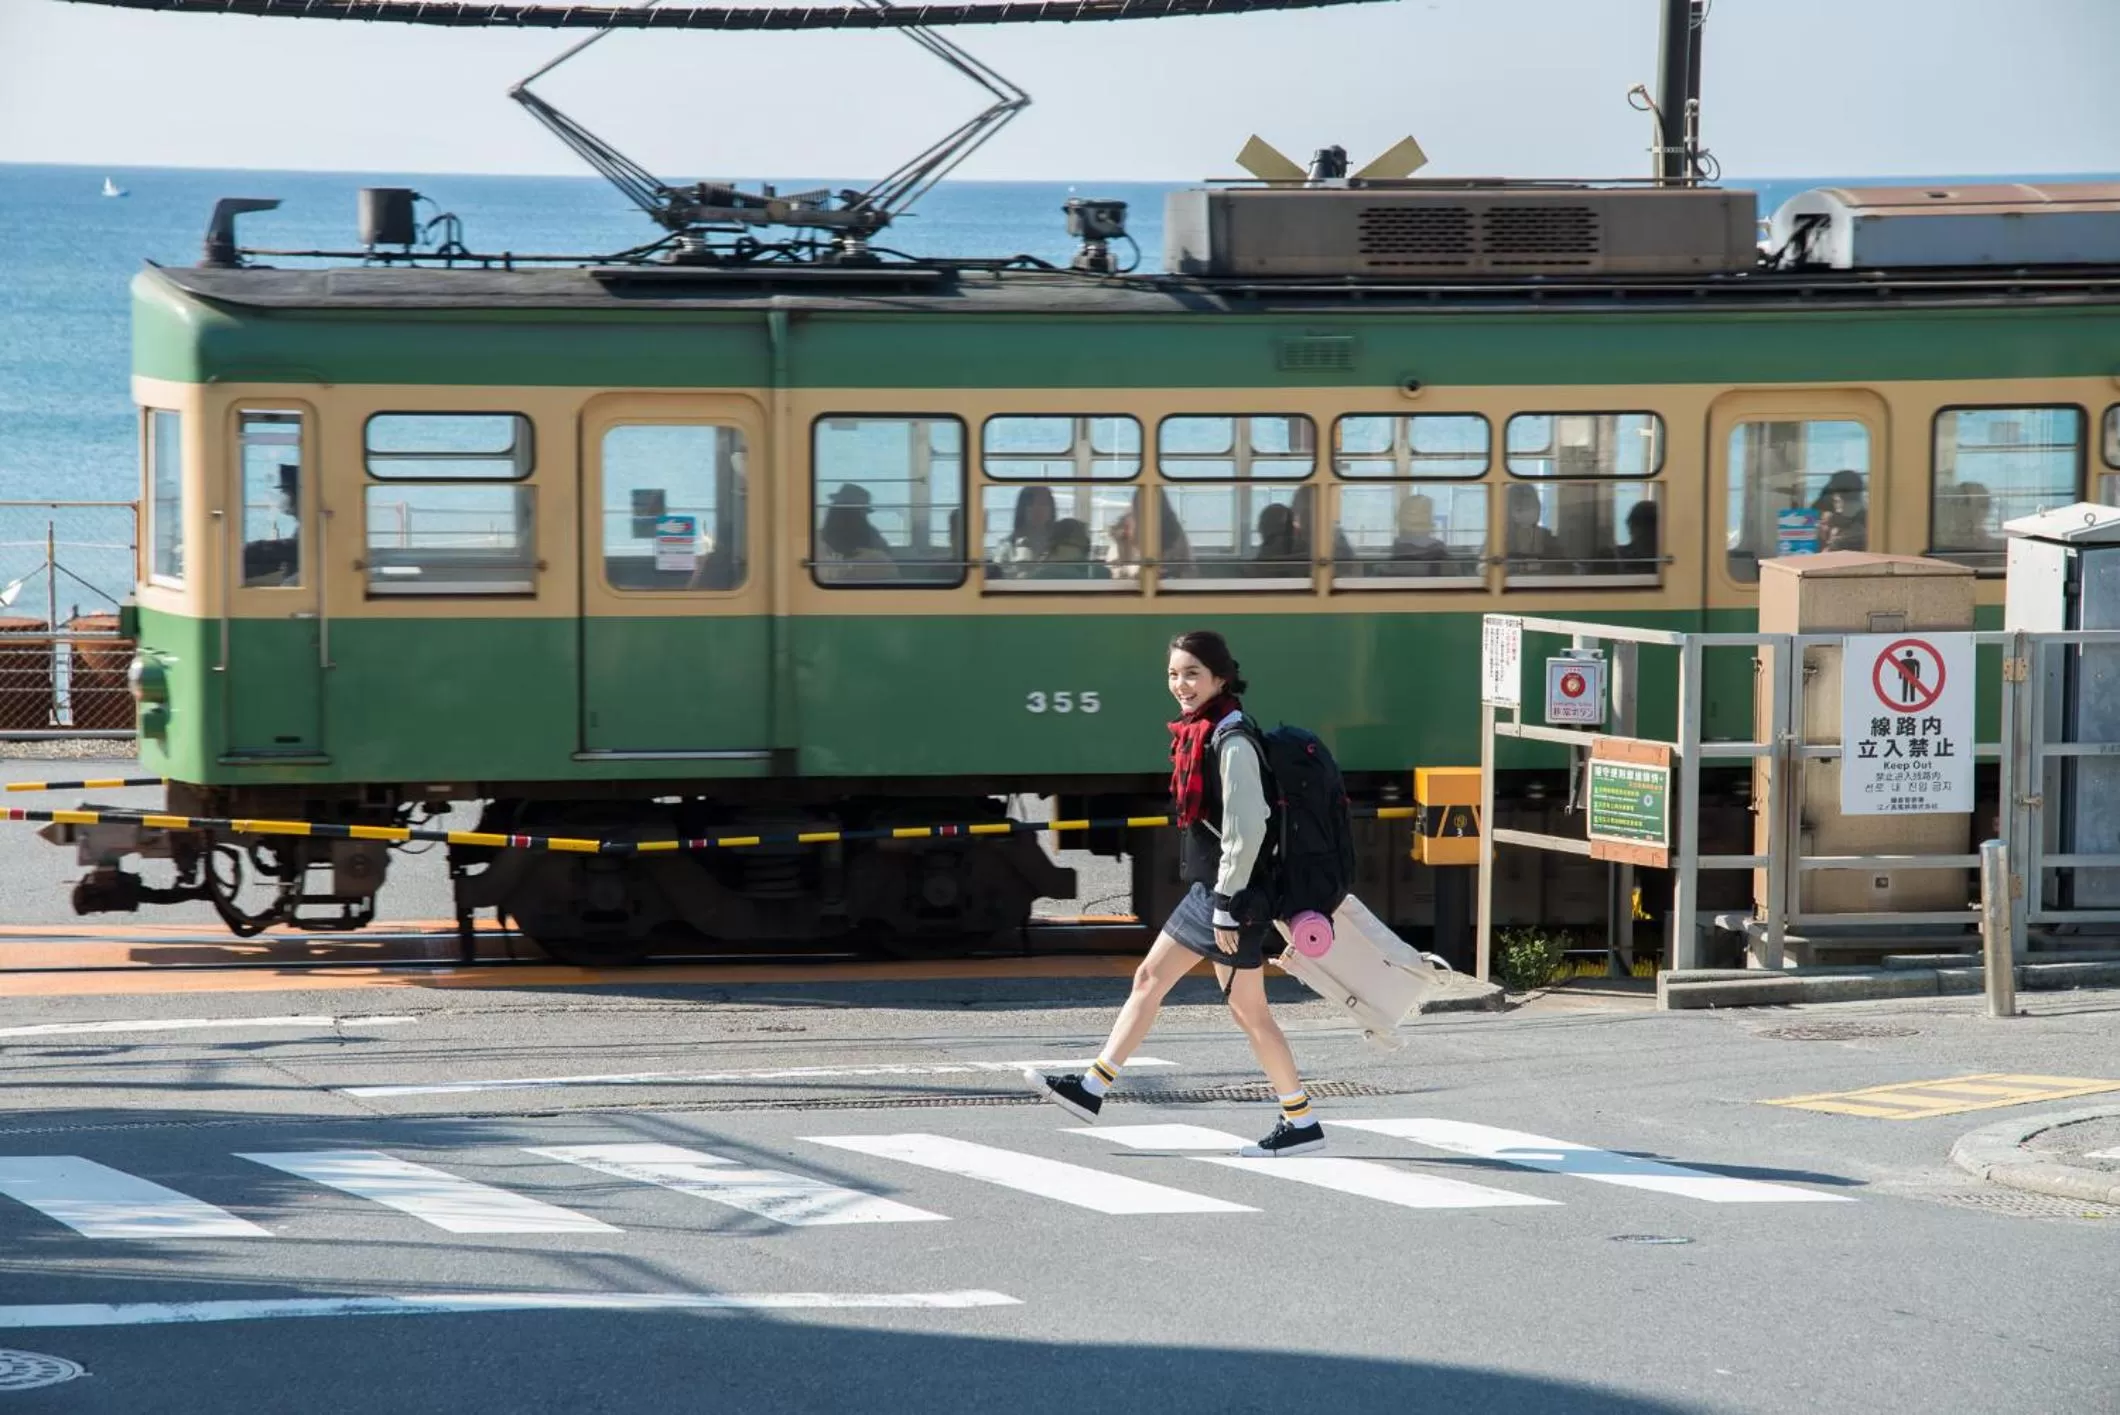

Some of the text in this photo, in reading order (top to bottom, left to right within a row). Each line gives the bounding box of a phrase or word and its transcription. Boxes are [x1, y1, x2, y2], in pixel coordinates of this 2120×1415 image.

[1025, 691, 1101, 713] 355
[1870, 716, 1942, 737] 線路内
[1857, 738, 1954, 759] 立入禁止
[1884, 761, 1932, 771] Keep Out
